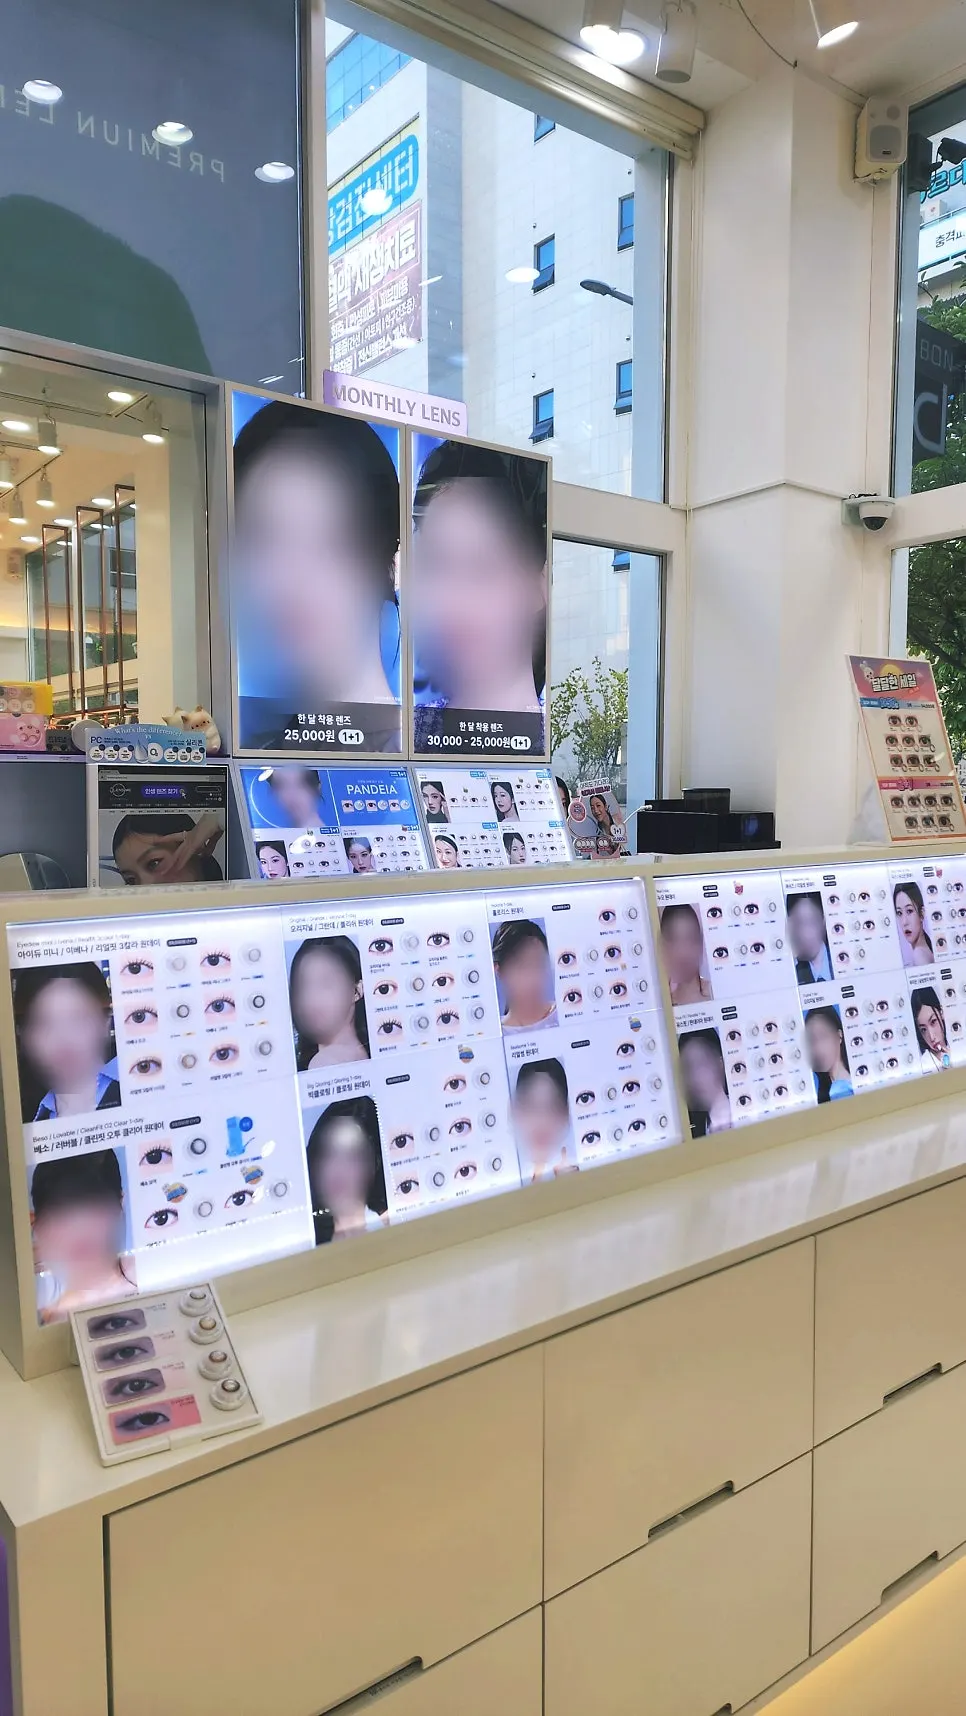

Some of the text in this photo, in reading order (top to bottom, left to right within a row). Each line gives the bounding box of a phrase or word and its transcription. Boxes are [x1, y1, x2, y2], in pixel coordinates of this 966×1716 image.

[333, 384, 461, 427] MONTHLY LENS
[872, 673, 899, 692] 달달한
[297, 713, 352, 726] 한 달 착용 렌즈
[459, 721, 503, 733] 한 달 착용 렌즈
[90, 736, 103, 744] PC
[284, 728, 360, 744] 25,000원 1+1
[427, 735, 462, 748] 30,000
[470, 736, 511, 749] 25,000원
[513, 738, 528, 746] 1+1
[346, 784, 398, 795] PANDEIA
[17, 949, 41, 959] 아이듀
[43, 947, 58, 956] 미니
[65, 944, 88, 955] 이베나
[140, 938, 161, 949] 원데이
[113, 1118, 129, 1128] Clear
[55, 1137, 78, 1150] 러버블
[84, 1132, 106, 1144] 클린핏
[106, 1129, 121, 1140] 오투
[122, 1125, 143, 1137] 클리어
[144, 1120, 165, 1133] 원데이
